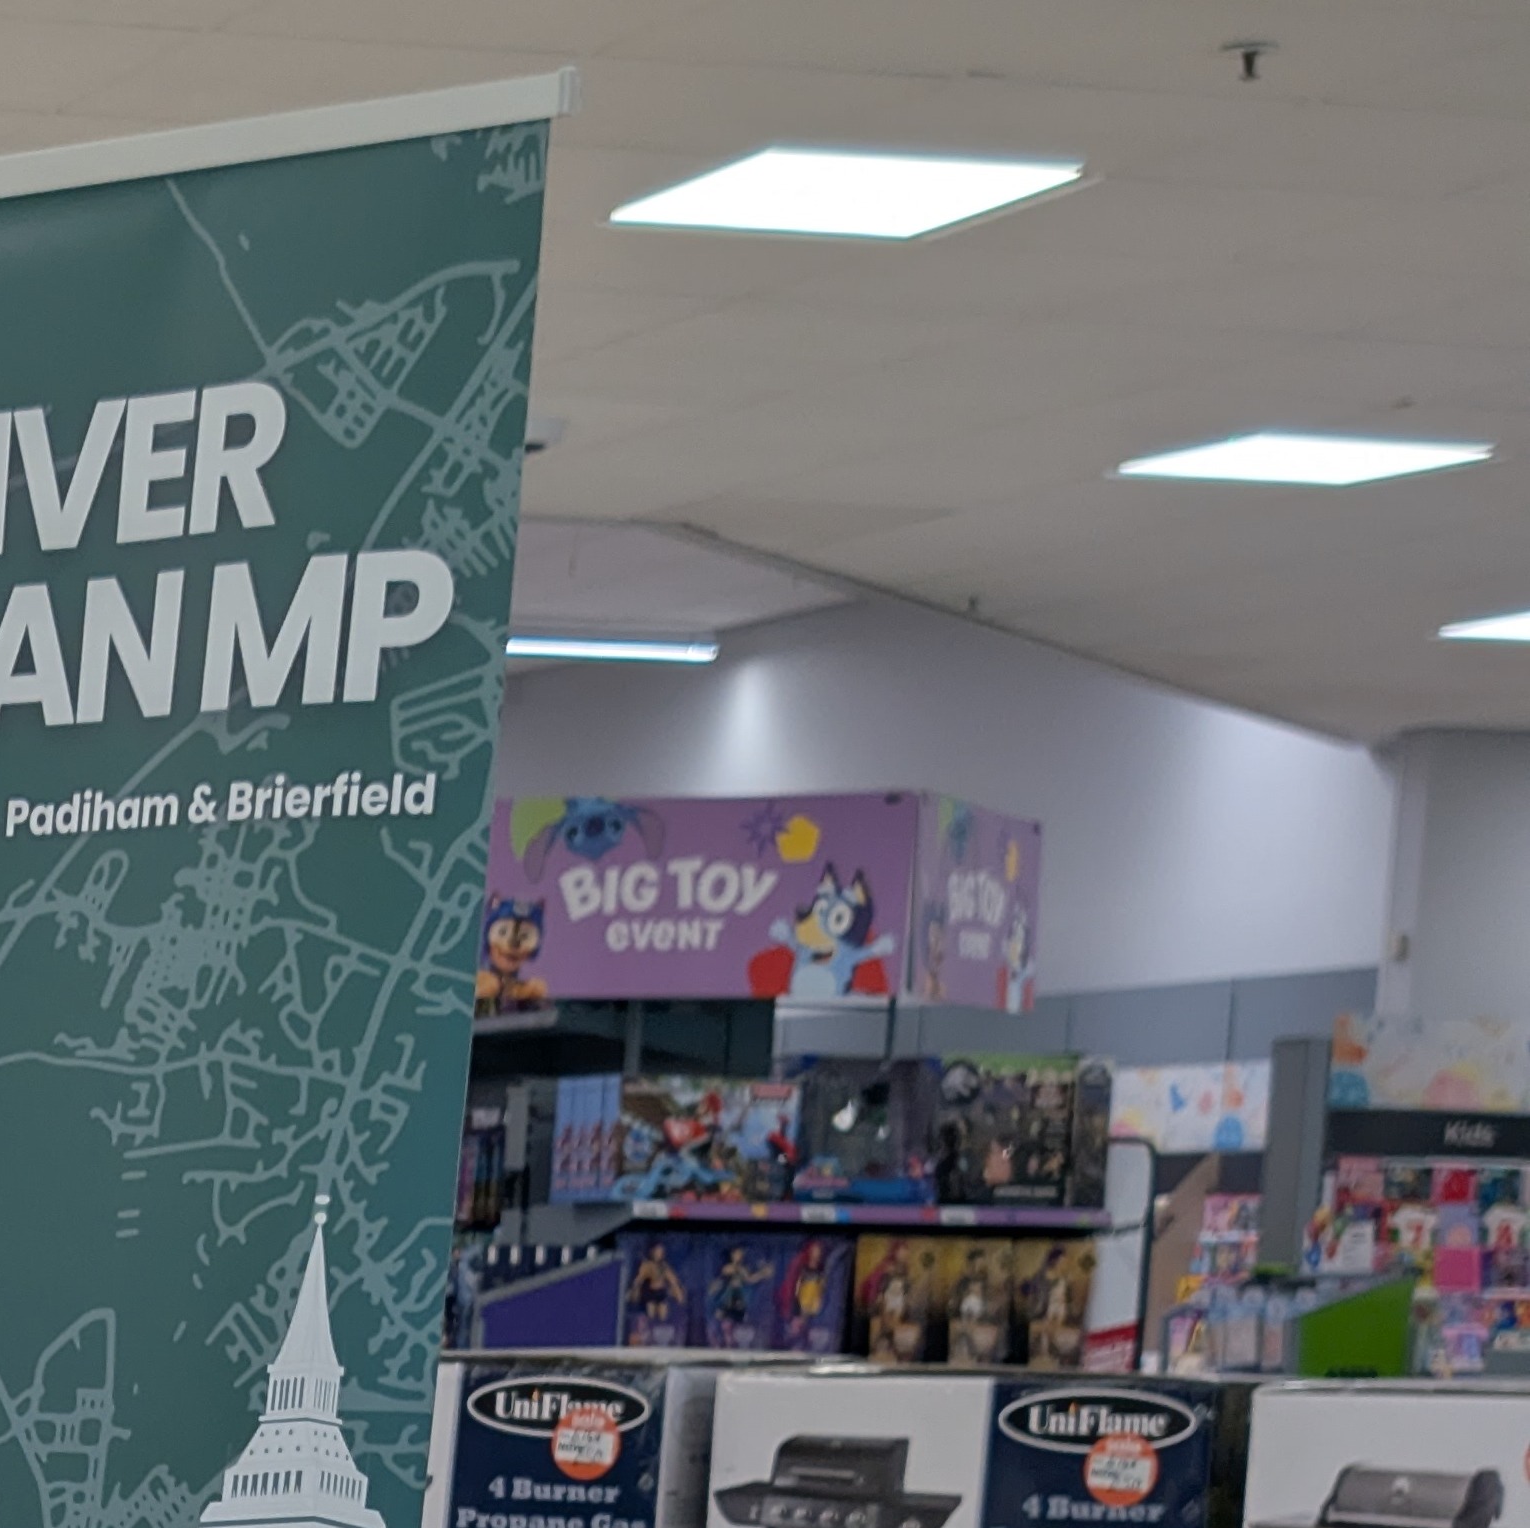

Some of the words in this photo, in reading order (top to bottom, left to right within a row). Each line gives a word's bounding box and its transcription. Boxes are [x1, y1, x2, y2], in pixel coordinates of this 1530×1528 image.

[200, 548, 455, 715] MP
[6, 787, 178, 839] Padiham
[188, 785, 218, 823] &
[227, 772, 437, 823] Brierfield
[558, 863, 662, 923] BIG
[666, 856, 778, 915] TOY
[1442, 1121, 1497, 1146] Kids
[1028, 1402, 1170, 1437] UniFlame
[487, 1476, 505, 1499] 4
[511, 1476, 622, 1504] Burner
[1021, 1497, 1041, 1519] 4
[1045, 1497, 1164, 1524] Burner
